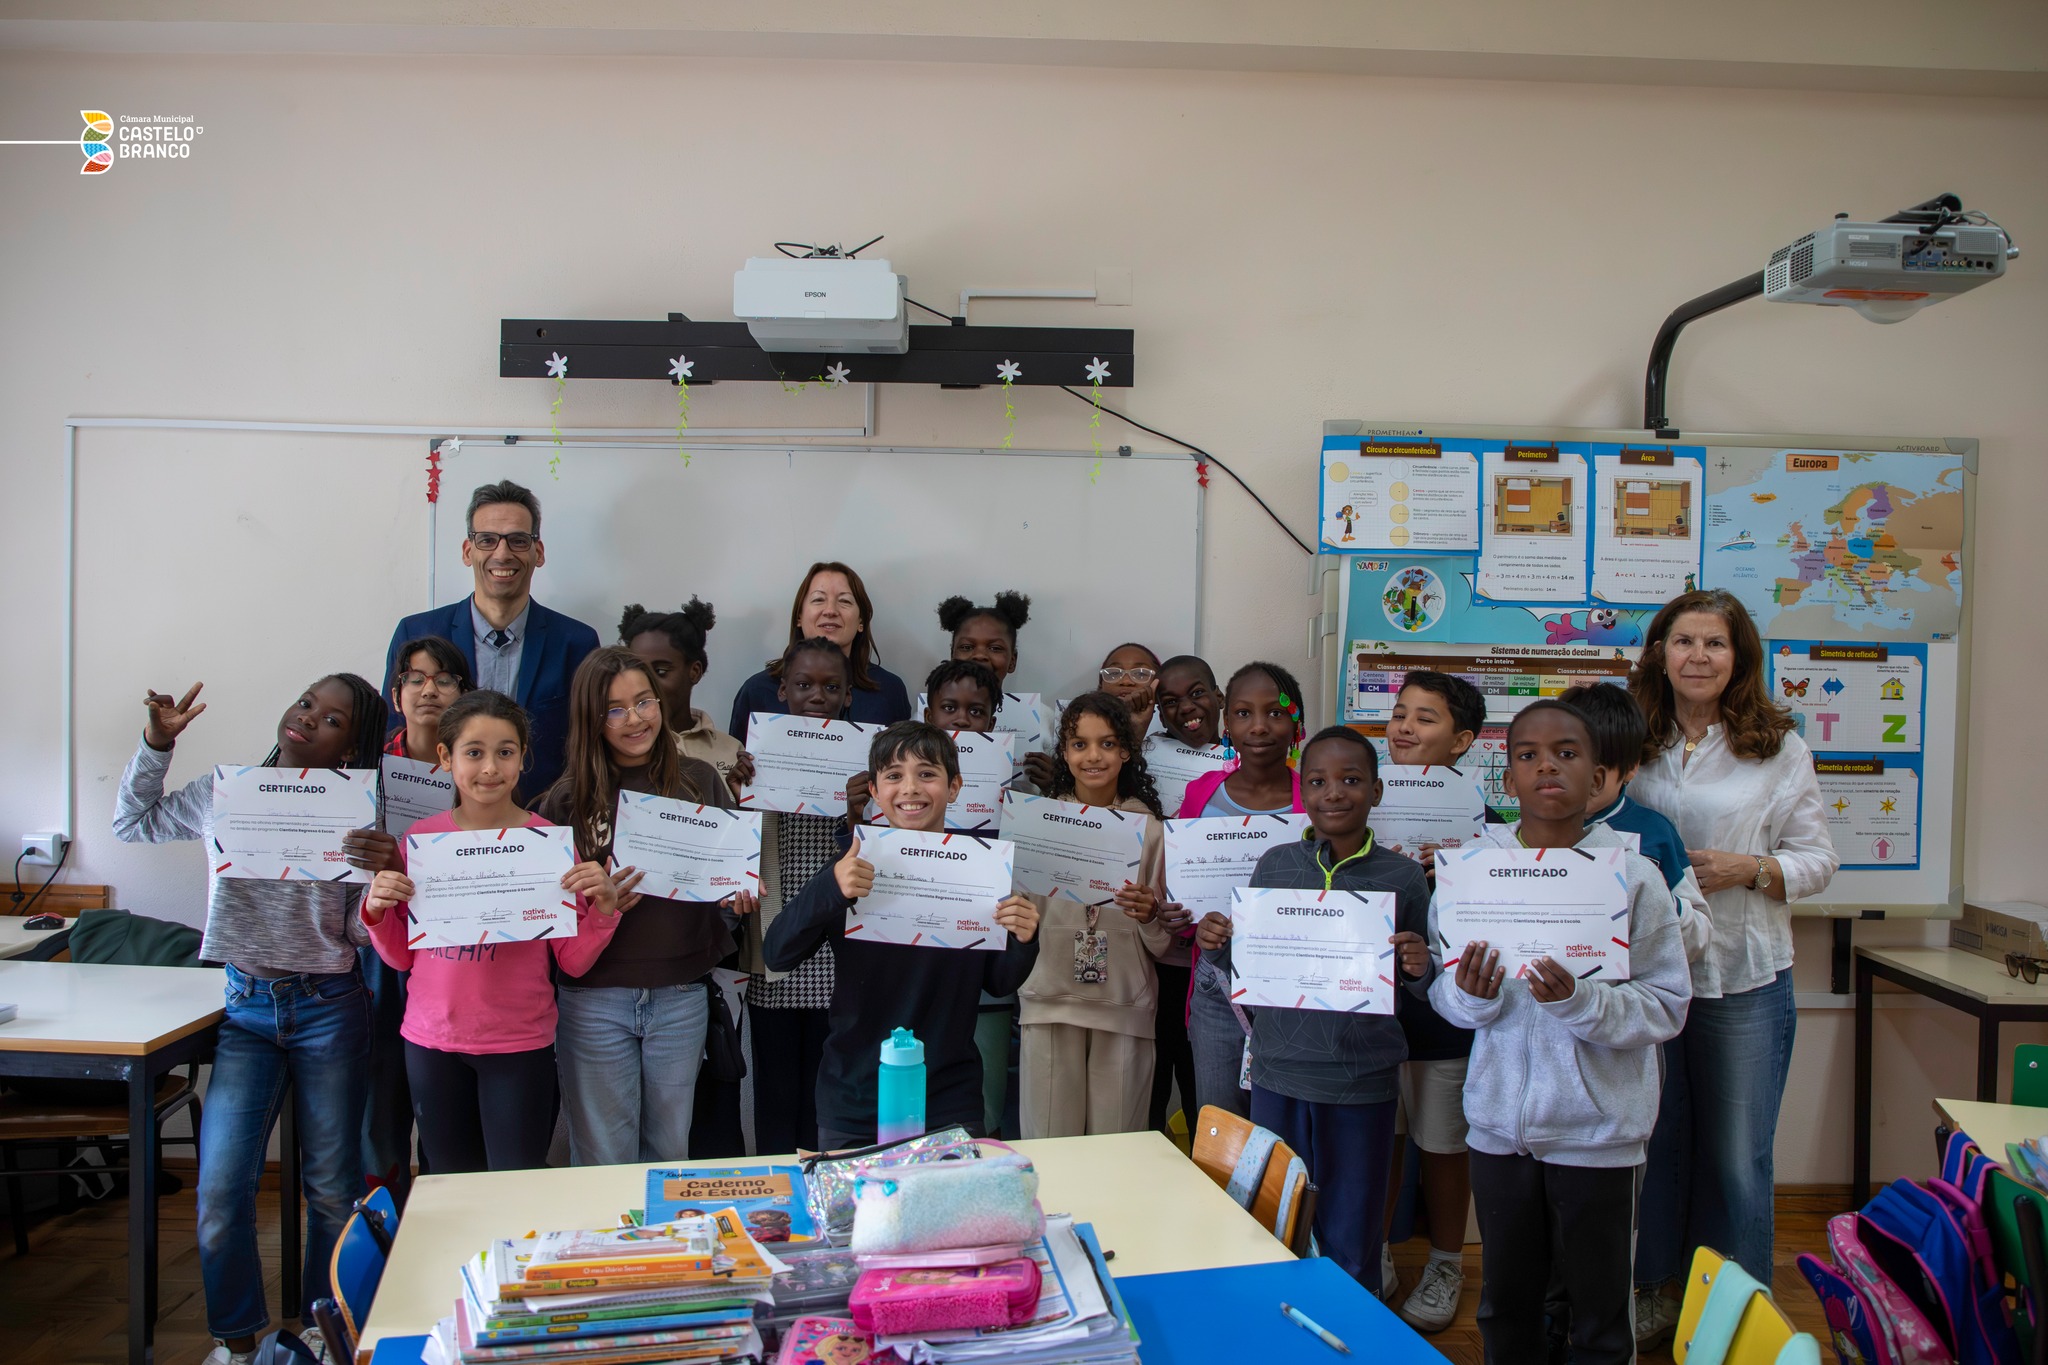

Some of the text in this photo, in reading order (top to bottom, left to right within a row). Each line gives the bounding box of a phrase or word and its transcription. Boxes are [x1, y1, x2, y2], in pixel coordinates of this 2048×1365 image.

[1394, 446, 1435, 454] circunferência
[1518, 451, 1547, 459] Perímetro
[1641, 453, 1655, 462] Área
[1793, 458, 1828, 470] Europa
[1357, 561, 1388, 571] VAMOS!
[1531, 648, 1570, 656] numeração
[1816, 713, 1840, 741] T
[1882, 715, 1906, 743] Z
[787, 729, 843, 742] CERTIFICADO
[391, 772, 451, 790] CERTIFICADO
[1388, 780, 1444, 788] CERTIFICADO
[259, 784, 326, 794] CERTIFICADO
[659, 812, 718, 829] CERTIFICADO
[1043, 812, 1102, 829] CERTIFICADO
[1206, 831, 1268, 841] CERTIFICADO
[456, 845, 525, 856] CERTIFICADO
[900, 847, 968, 861] CERTIFICADO
[1489, 868, 1568, 878] CERTIFICADO
[523, 913, 557, 921] scientists
[1276, 907, 1344, 917] CERTIFICADO
[1566, 950, 1606, 958] scientists
[1340, 985, 1374, 993] scientists
[687, 1179, 765, 1189] Caderno
[680, 1187, 774, 1197] de Estudo
